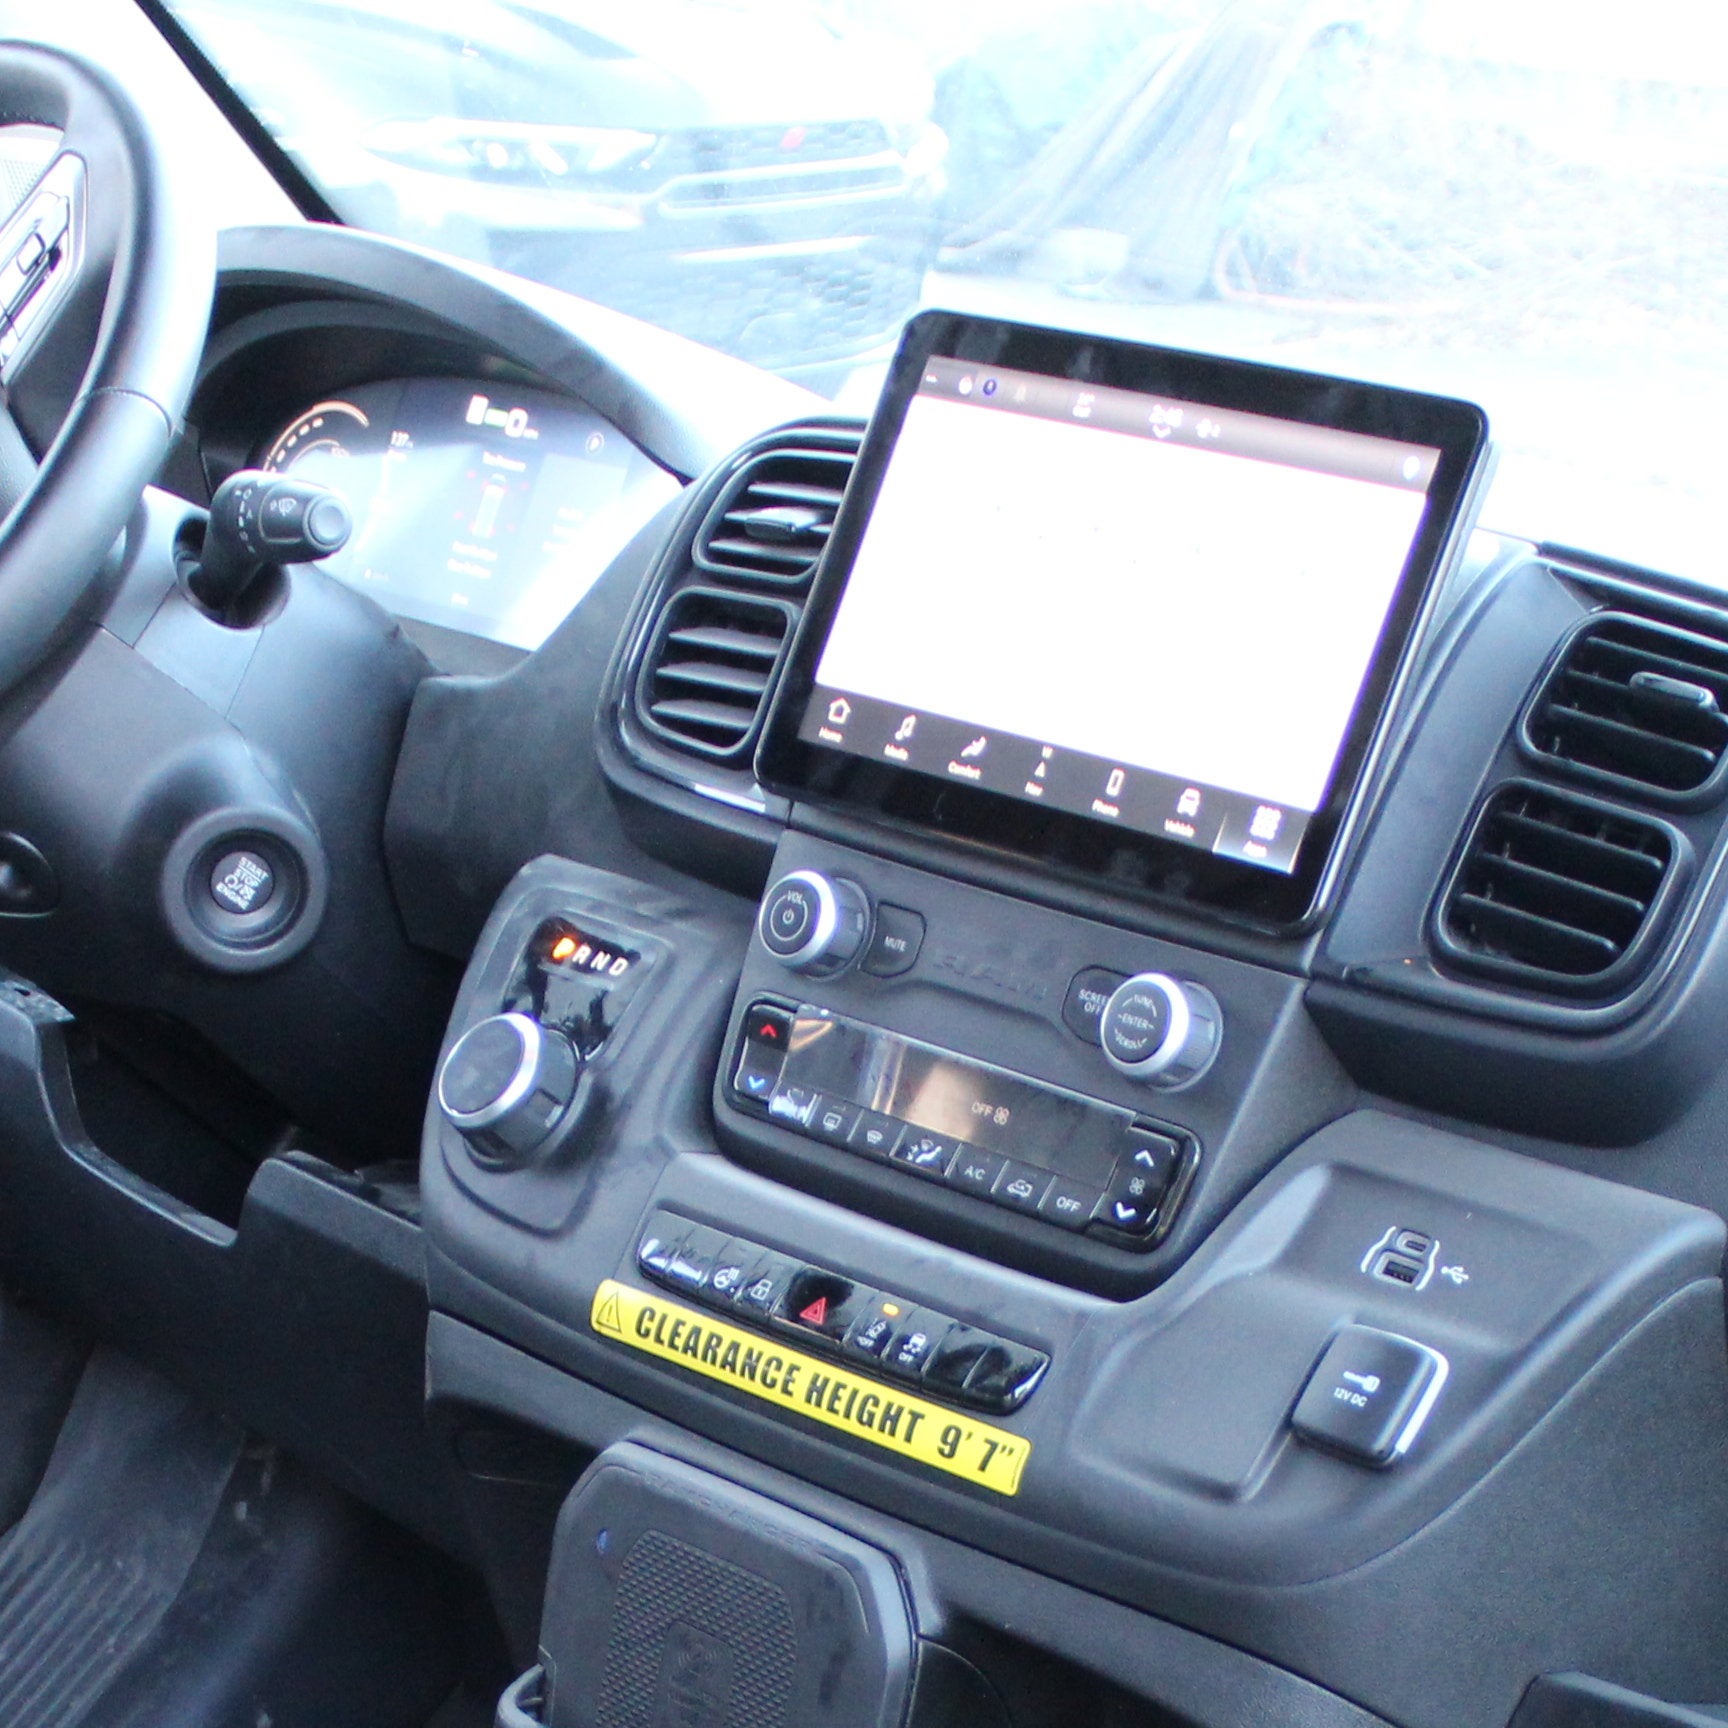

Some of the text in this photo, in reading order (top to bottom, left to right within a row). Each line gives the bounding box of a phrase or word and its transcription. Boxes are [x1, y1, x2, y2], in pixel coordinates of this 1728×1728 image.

[234, 868, 259, 887] STOP
[239, 856, 269, 881] START
[216, 882, 250, 910] ENGINE
[787, 890, 803, 905] VOL
[884, 936, 907, 952] MUTE
[590, 950, 611, 971] N
[608, 956, 629, 976] D
[972, 1101, 993, 1117] OFF
[964, 1165, 986, 1181] A/C
[1056, 1196, 1082, 1213] OFF
[635, 1305, 803, 1398] CLEARANCE
[804, 1372, 926, 1445] HEIGHT
[1334, 1387, 1368, 1407] 12V DC
